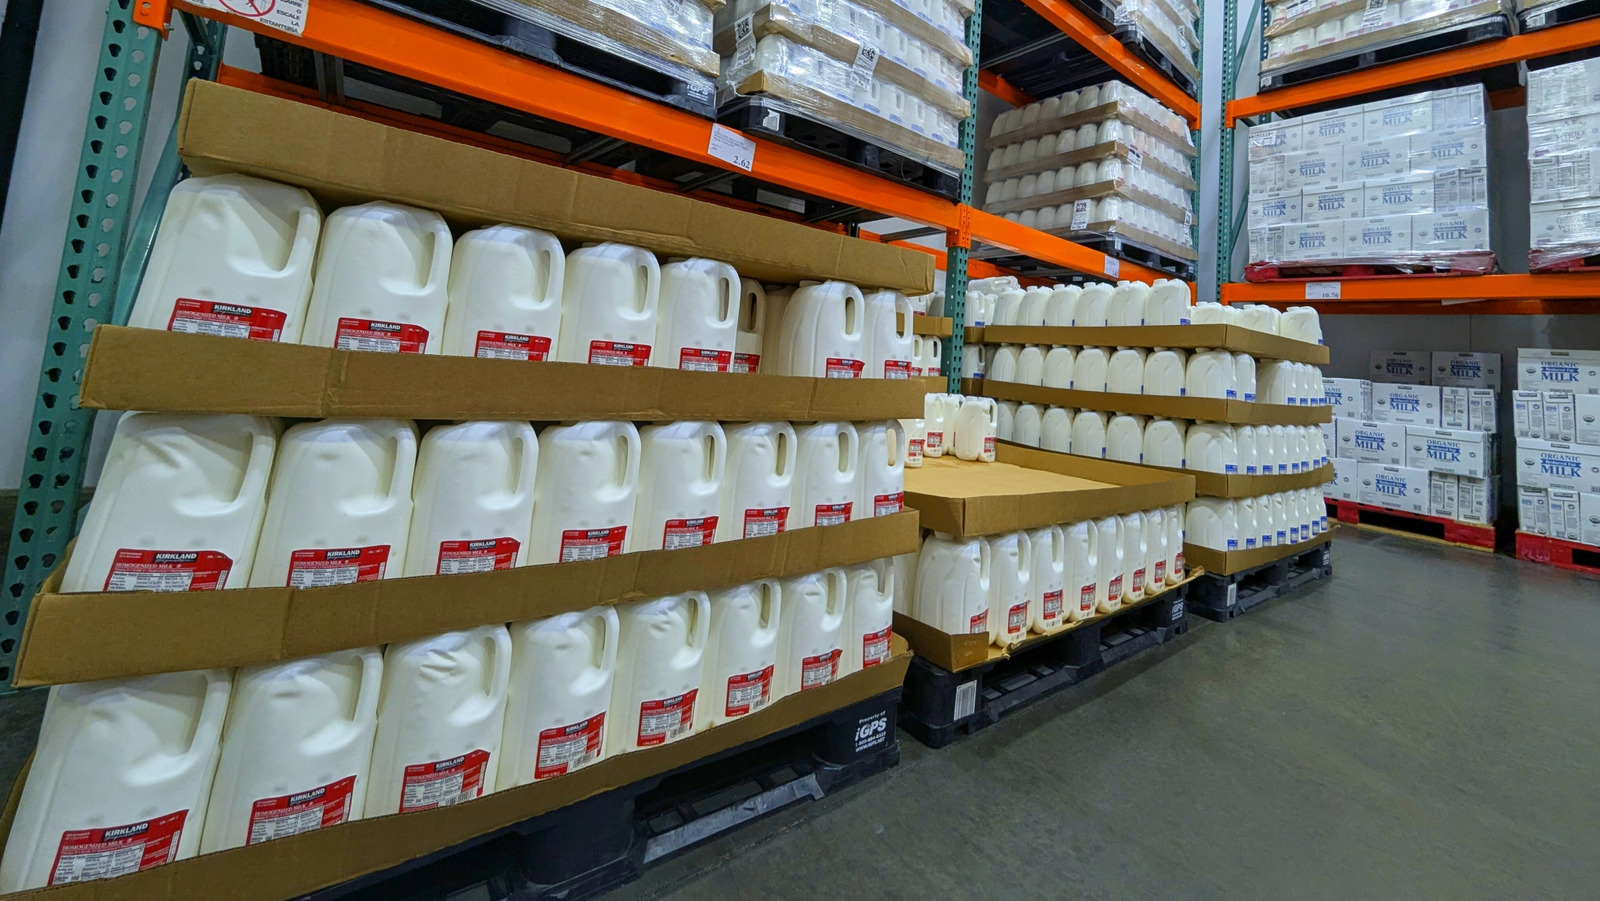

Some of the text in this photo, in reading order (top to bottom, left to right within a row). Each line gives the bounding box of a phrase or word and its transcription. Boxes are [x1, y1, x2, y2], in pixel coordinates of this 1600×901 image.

[276, 10, 300, 20] ESCALE
[1382, 115, 1412, 126] MILK
[1319, 127, 1346, 137] MILK
[1431, 148, 1464, 159] MILK
[734, 156, 750, 168] 2.62
[1360, 157, 1390, 168] MILK
[1300, 165, 1326, 176] MILK
[1382, 194, 1413, 205] MILK
[1318, 202, 1346, 211] MILK
[1262, 208, 1286, 218] MILK
[1362, 236, 1392, 245] MILK
[1434, 231, 1467, 241] MILK
[214, 304, 252, 314] KIRKLAND
[1386, 367, 1413, 375] MILK
[1450, 369, 1481, 378] MILK
[1541, 372, 1579, 382] MILK
[1390, 402, 1420, 412] MILK
[1355, 440, 1385, 451] MILK
[1427, 450, 1460, 462] MILK
[1541, 452, 1580, 462] ORGANIC
[1541, 464, 1582, 478] MILK
[1376, 474, 1406, 482] ORGANIC
[1376, 484, 1407, 497] MILK
[859, 714, 880, 724] Property
[855, 717, 887, 741] iGPS
[435, 756, 464, 768] KIRKLAND
[290, 788, 325, 802] KIRKLAND
[105, 823, 148, 838] KIRKLAND
